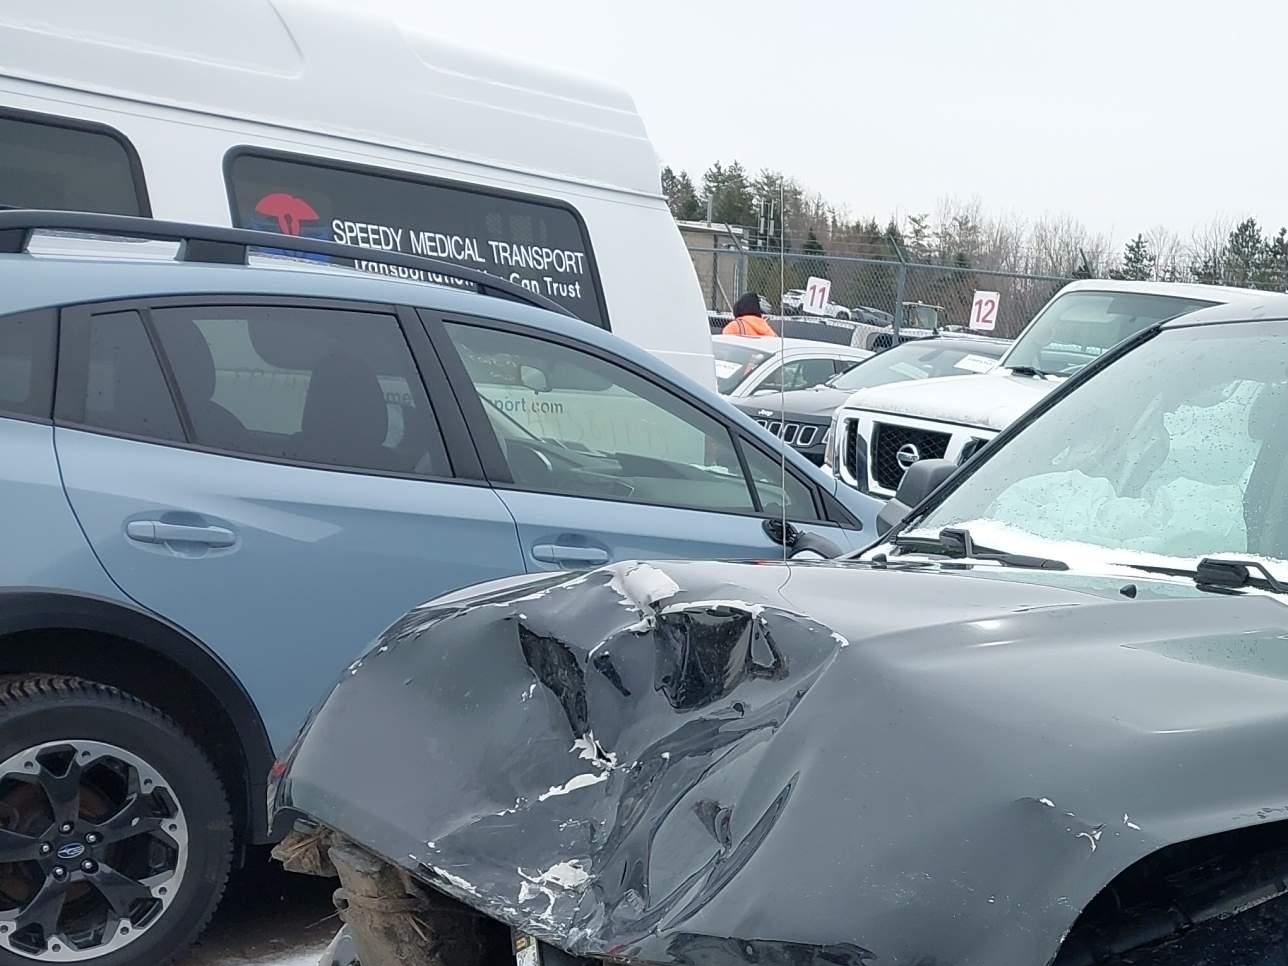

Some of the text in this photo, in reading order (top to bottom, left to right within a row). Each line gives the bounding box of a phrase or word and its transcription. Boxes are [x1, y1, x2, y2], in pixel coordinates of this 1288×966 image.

[332, 219, 402, 252] SPEEDY
[408, 230, 486, 263] MEDICAL
[488, 240, 585, 275] TRANSPORT
[543, 277, 582, 299] Trust
[809, 285, 828, 310] 11
[973, 299, 996, 324] 12
